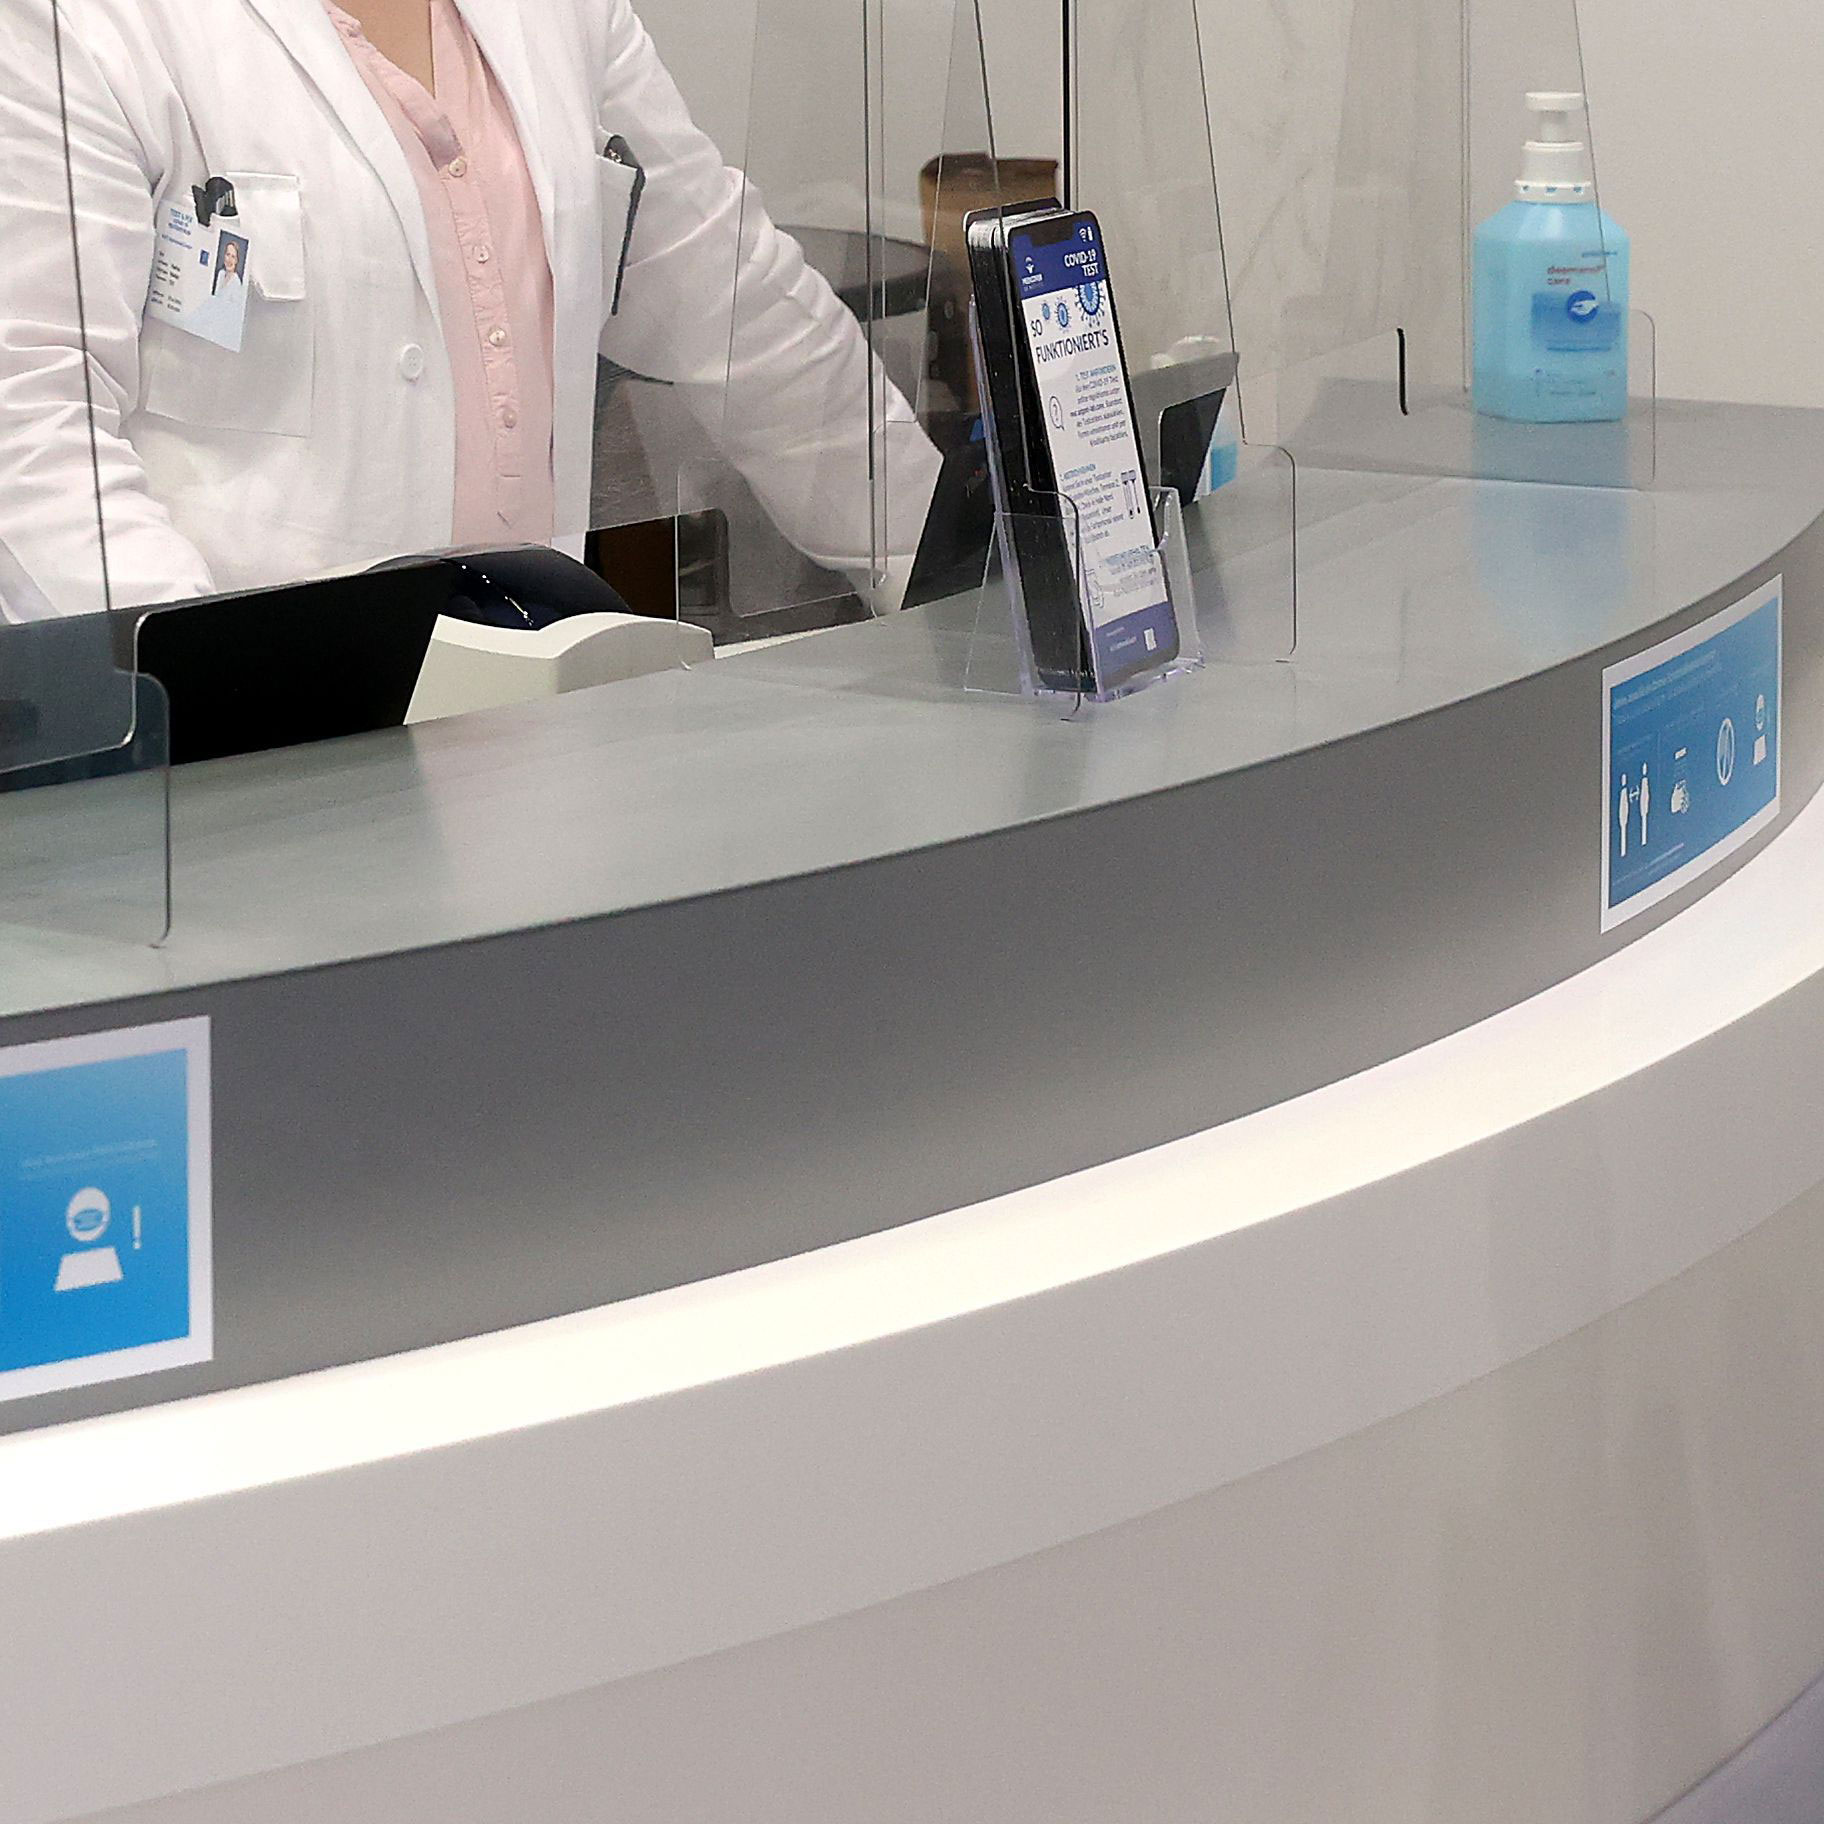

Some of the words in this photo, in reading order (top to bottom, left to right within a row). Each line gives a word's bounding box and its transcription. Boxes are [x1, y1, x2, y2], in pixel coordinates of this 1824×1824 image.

[1063, 248, 1098, 268] COVID-19
[1080, 262, 1100, 278] TEST
[1030, 319, 1043, 338] SO
[1036, 329, 1109, 364] FUNKTIONIERT'S
